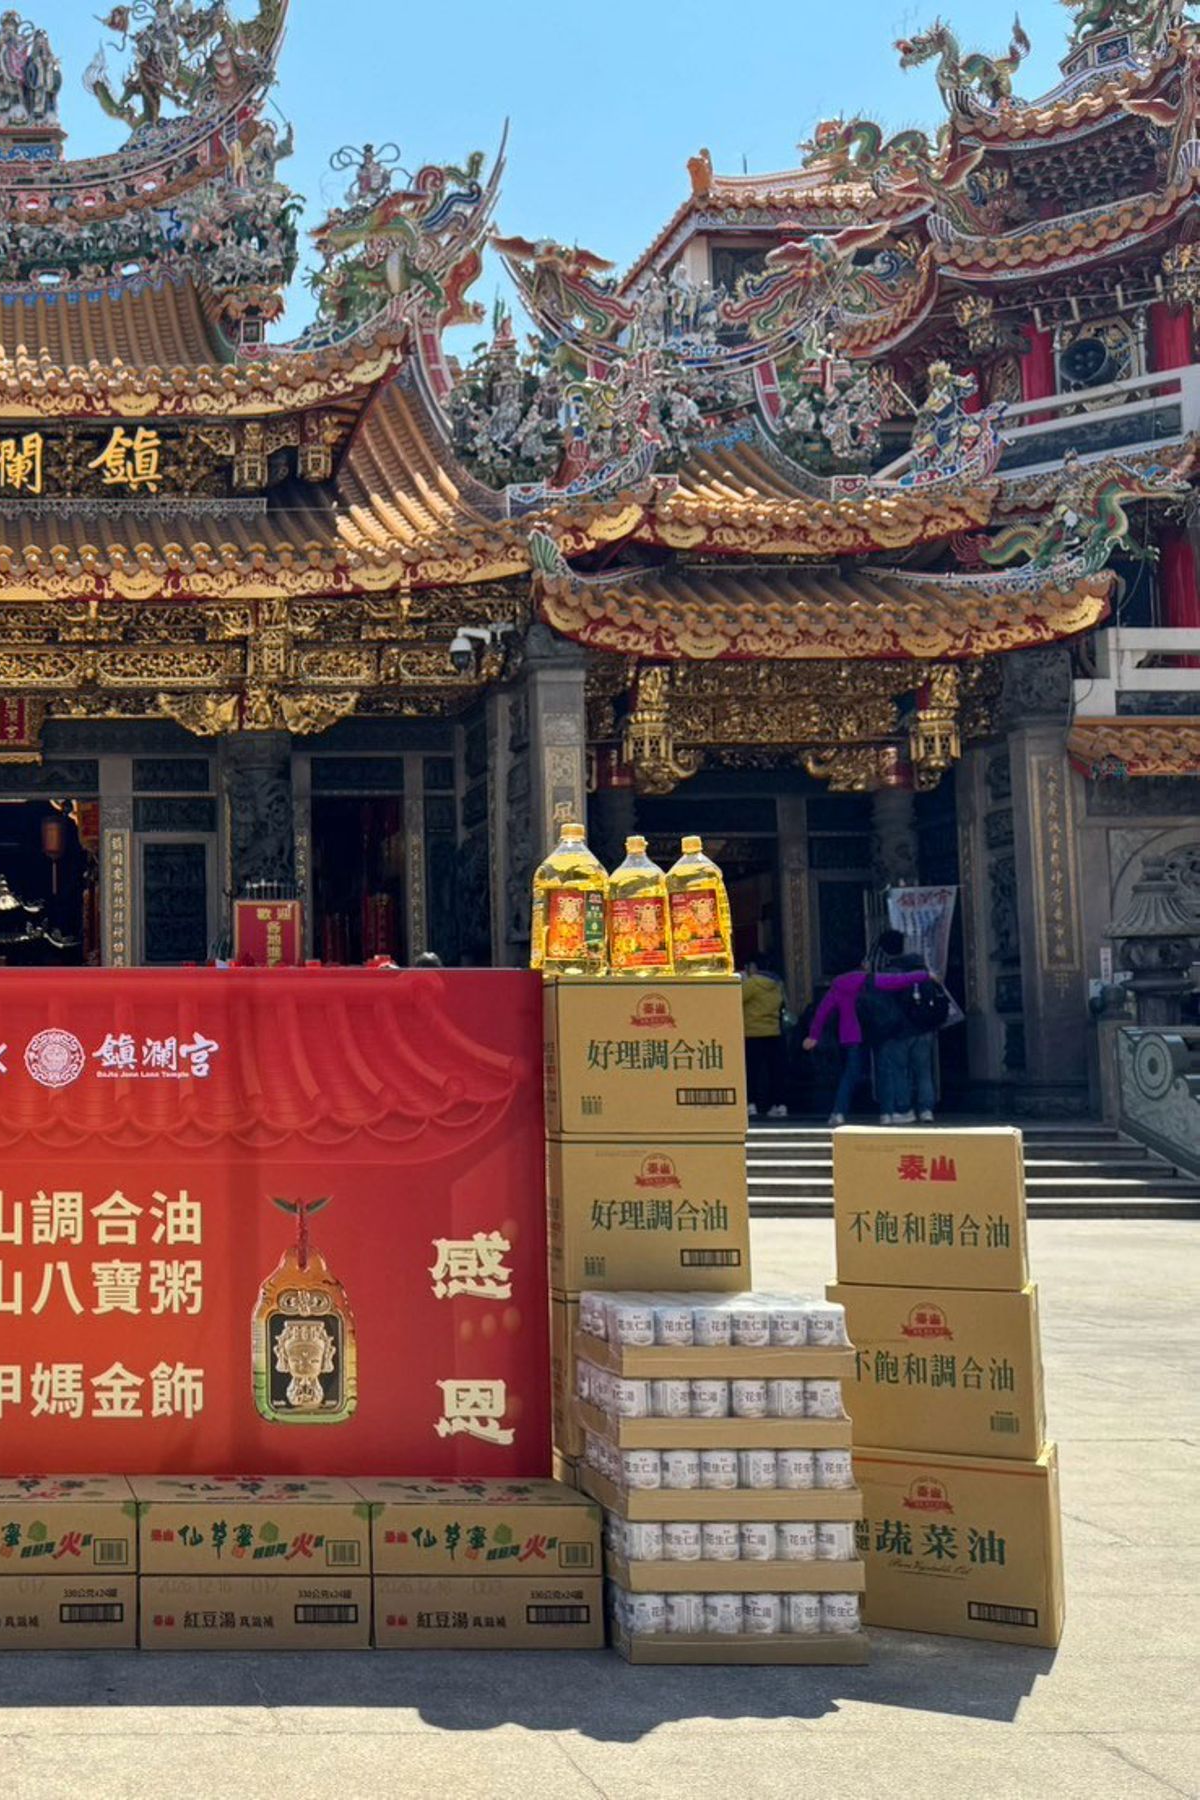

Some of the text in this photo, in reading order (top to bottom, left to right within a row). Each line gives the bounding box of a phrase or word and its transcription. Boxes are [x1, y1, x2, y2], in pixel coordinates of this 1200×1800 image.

[91, 1031, 220, 1078] 鎮瀾宮
[587, 1038, 724, 1071] 好理調合油
[897, 1154, 957, 1181] 泰山
[591, 1199, 728, 1232] 好理調合油
[847, 1209, 1011, 1249] 不飽和調合油
[428, 1230, 515, 1445] 感恩
[874, 1518, 1006, 1565] 蔬菜油
